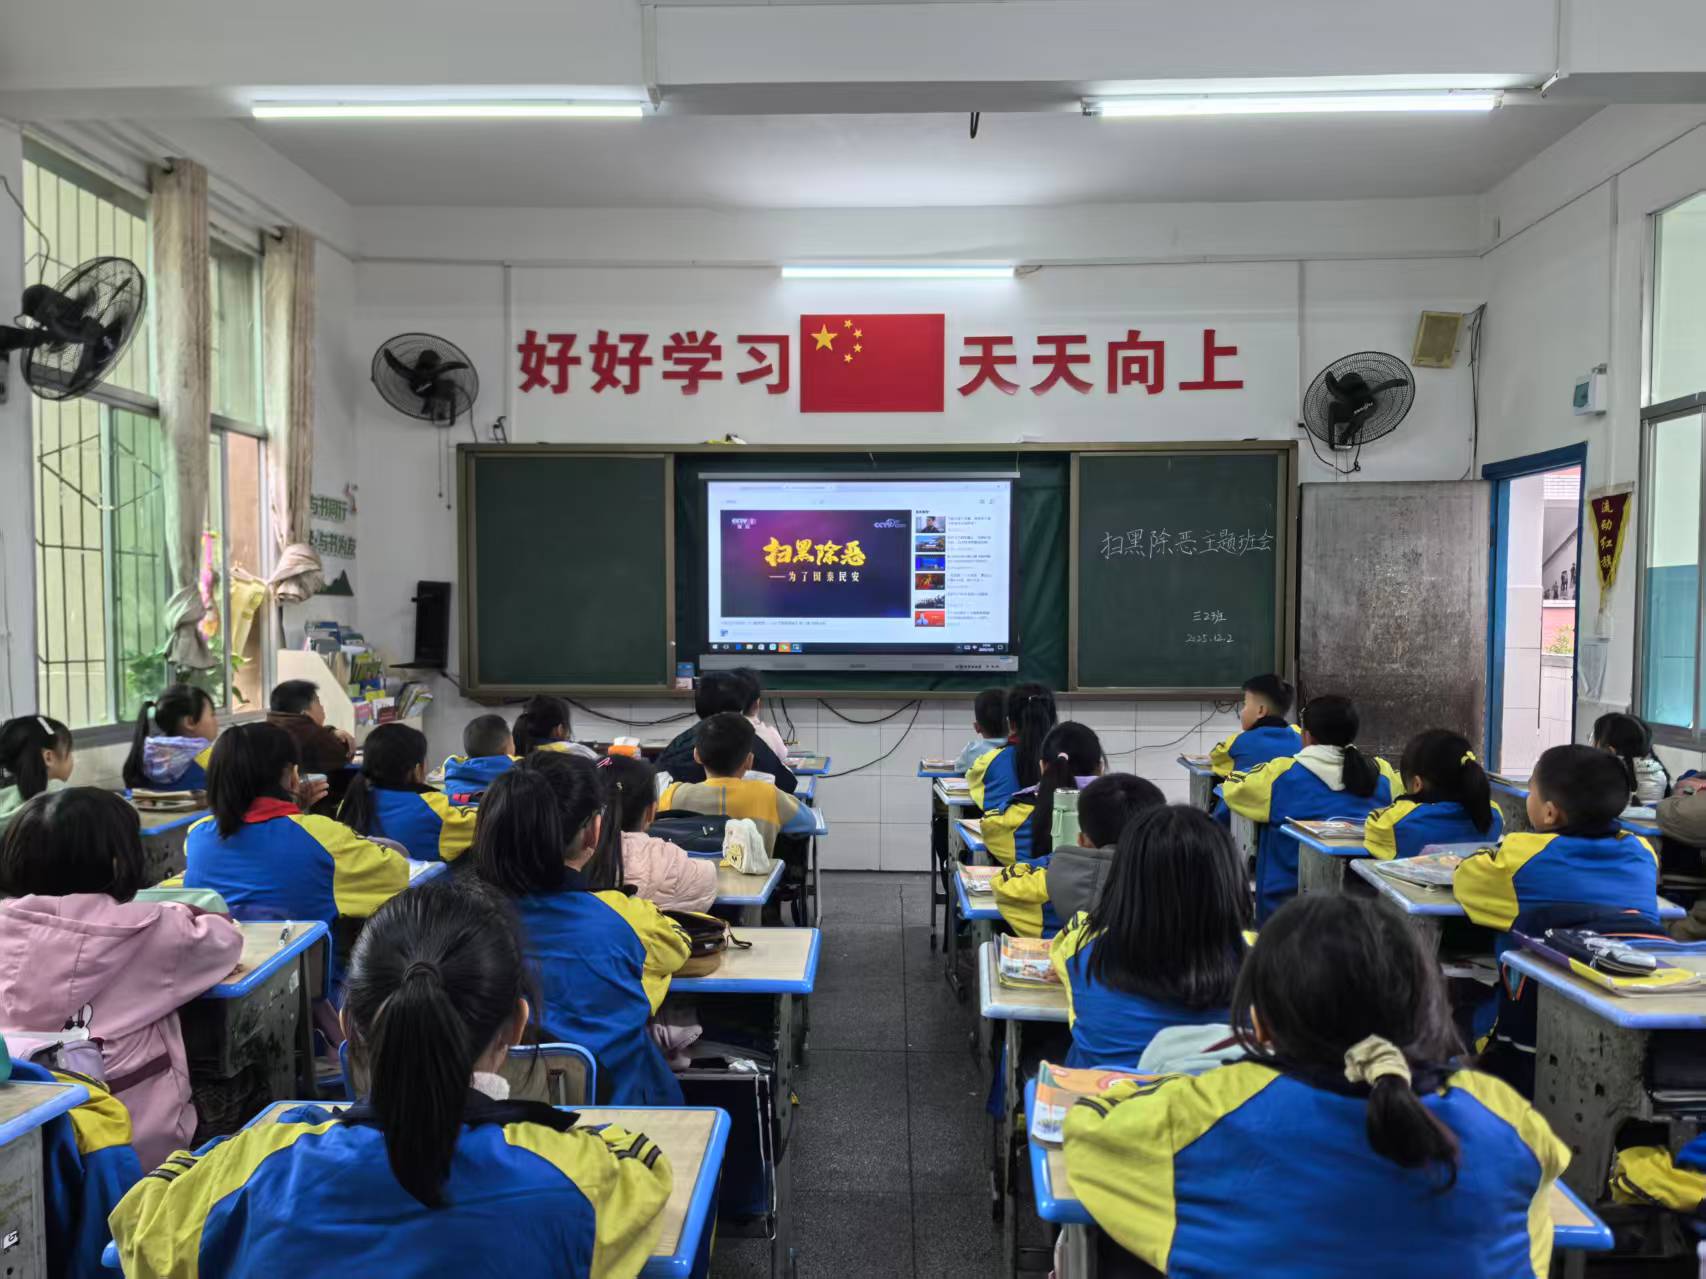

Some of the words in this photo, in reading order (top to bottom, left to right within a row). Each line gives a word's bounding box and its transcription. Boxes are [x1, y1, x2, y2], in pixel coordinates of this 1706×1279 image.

[517, 329, 790, 395] 好好学习
[957, 329, 1244, 396] 天天向上
[763, 537, 866, 567] 扫黑除恶
[1100, 527, 1275, 559] 扫黑除恶主题班会
[1600, 499, 1614, 568] 流动红旗
